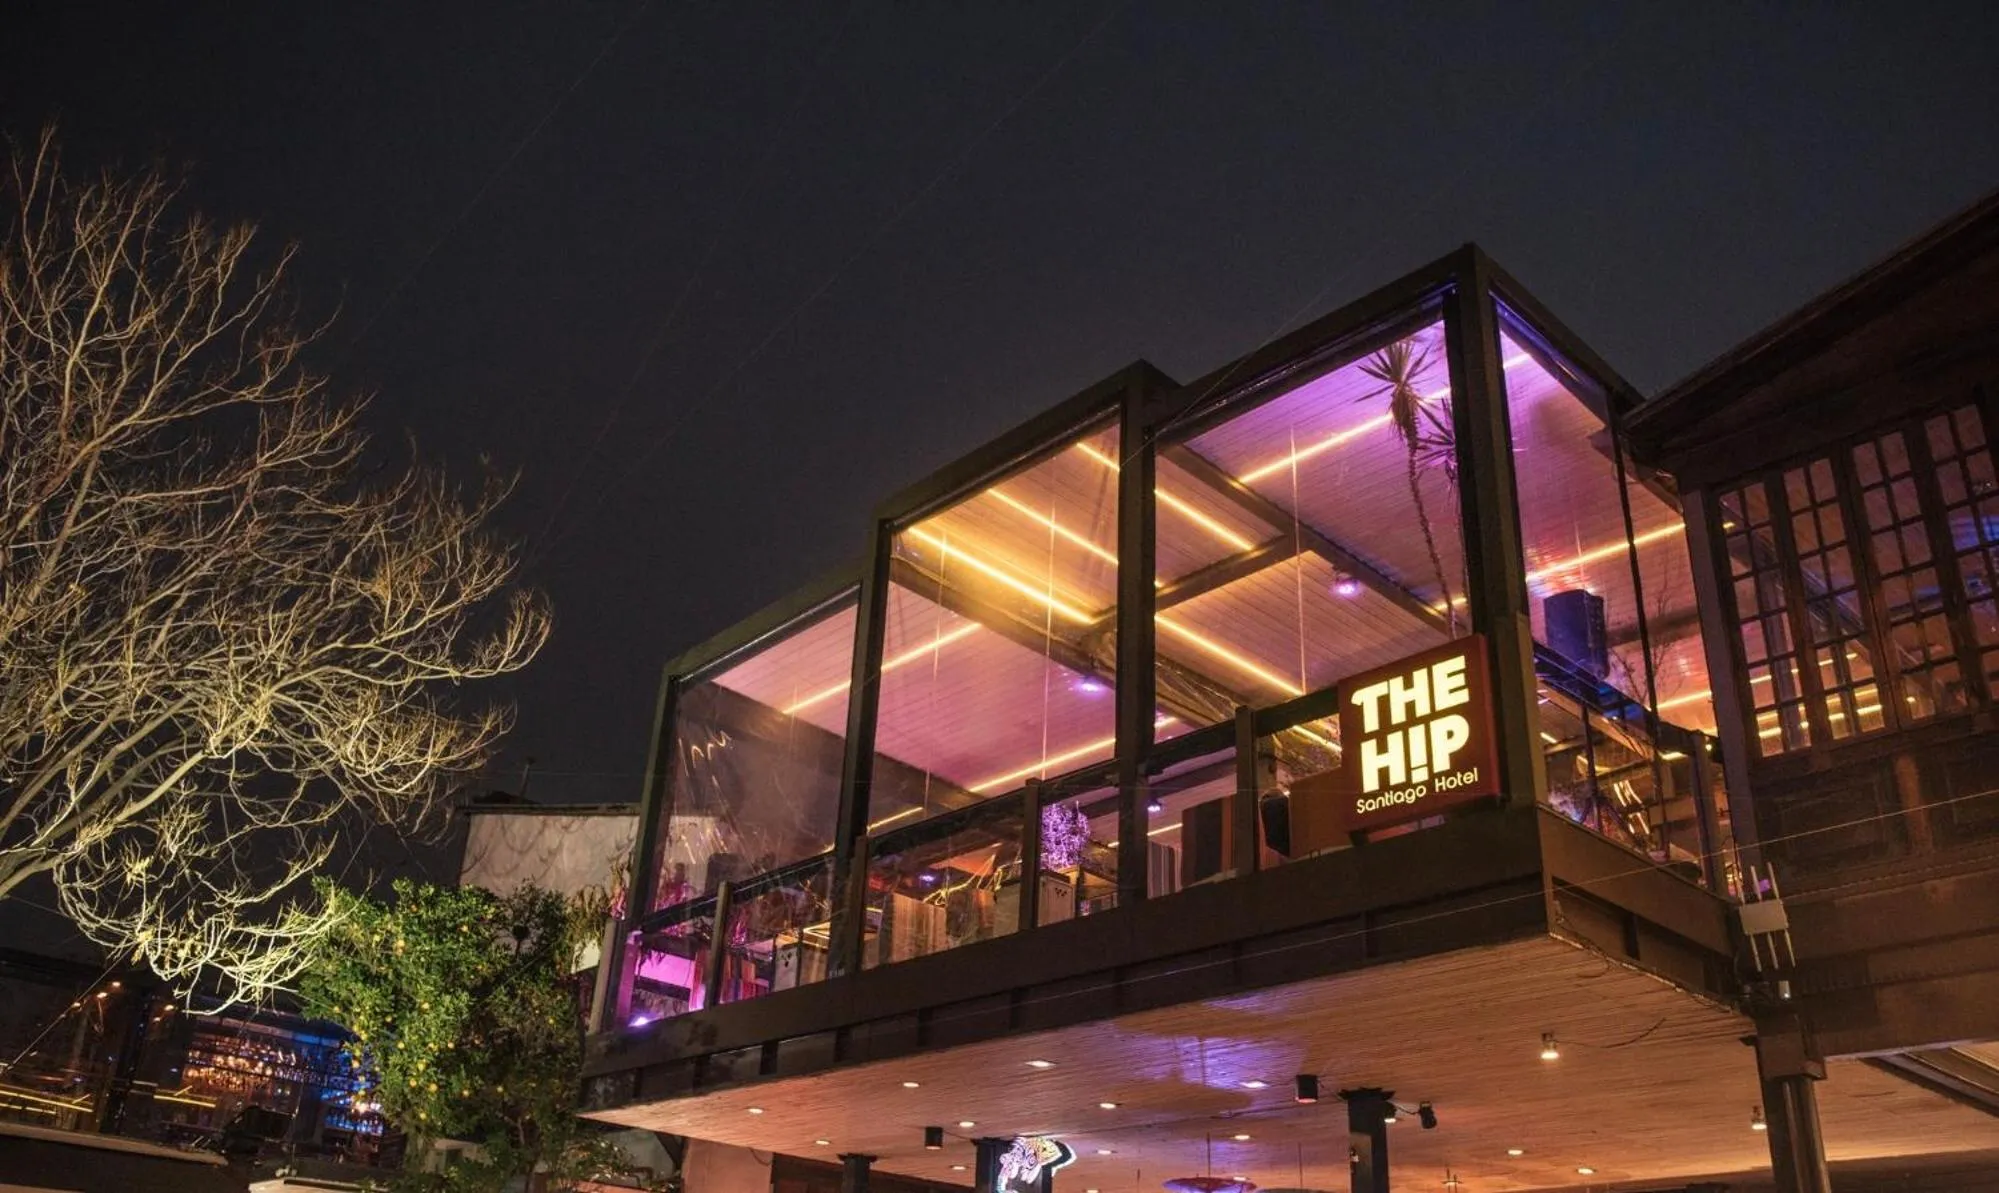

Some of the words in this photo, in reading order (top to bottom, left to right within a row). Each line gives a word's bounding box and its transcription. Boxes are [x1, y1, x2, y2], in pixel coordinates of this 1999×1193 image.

[1351, 655, 1470, 733] THE
[1357, 785, 1427, 814] Santiago
[1434, 767, 1479, 793] Hotel
